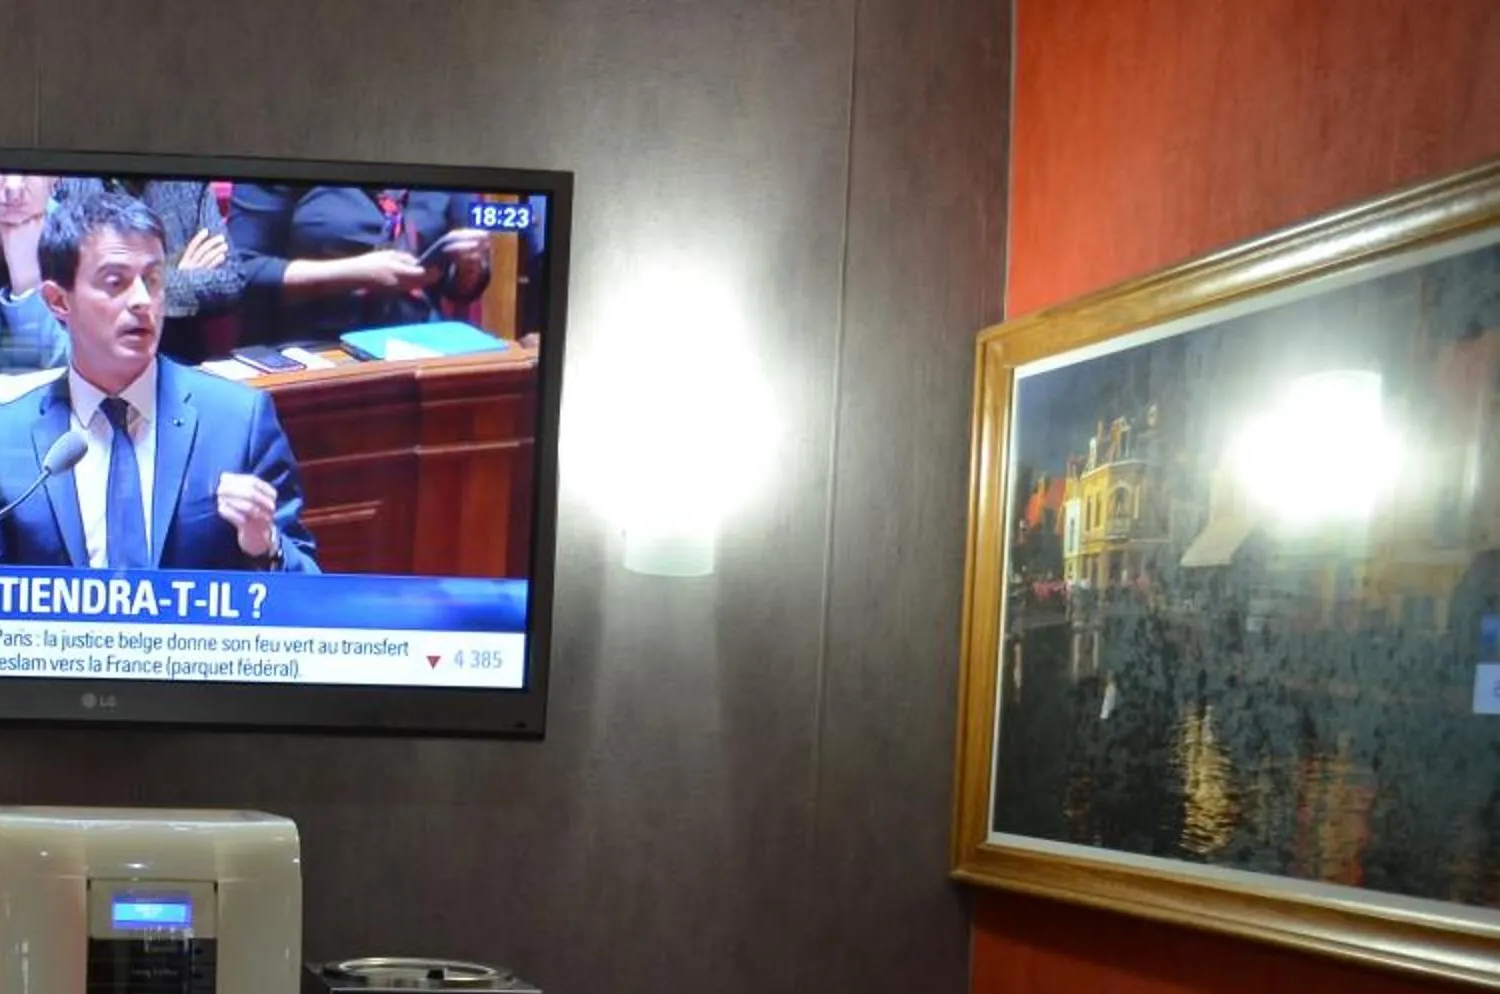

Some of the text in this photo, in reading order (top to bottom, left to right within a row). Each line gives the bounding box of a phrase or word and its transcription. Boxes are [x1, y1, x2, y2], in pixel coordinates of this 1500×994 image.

[471, 206, 530, 229] 18:23
[248, 583, 267, 619] ?
[44, 630, 57, 648] la
[61, 631, 114, 651] justice
[118, 632, 163, 654] belge
[167, 633, 217, 651] donne
[221, 638, 251, 652] son
[255, 634, 281, 653] feu
[283, 637, 314, 654] vert
[318, 640, 339, 654] au
[341, 637, 409, 657] transfert
[50, 657, 85, 673] vers
[88, 654, 102, 672] la
[106, 655, 163, 674] France
[166, 656, 233, 680] (parquet
[470, 650, 503, 669] 385
